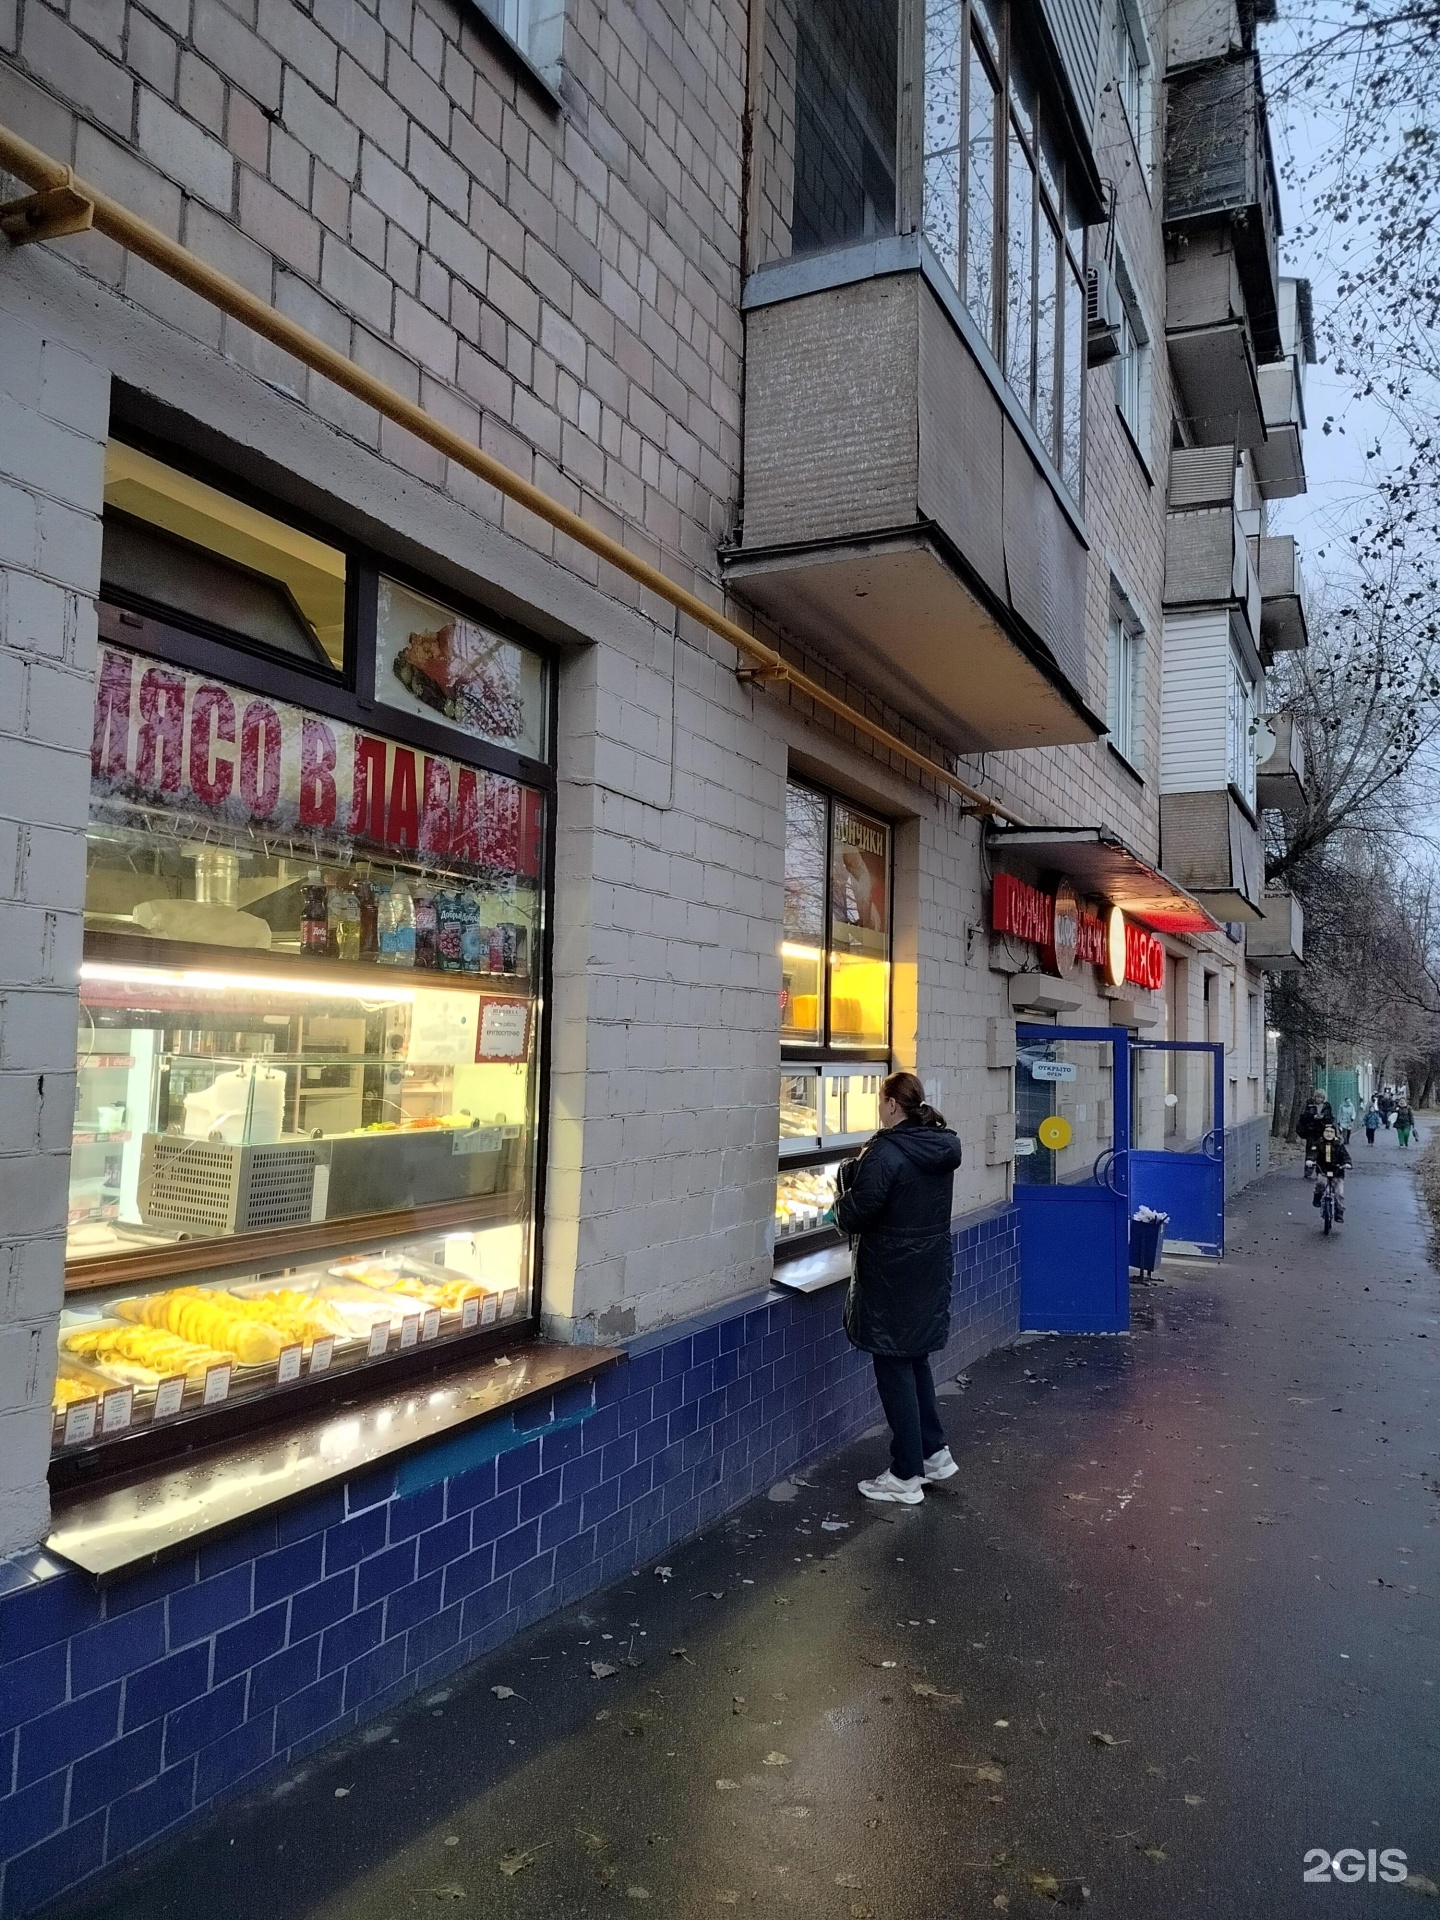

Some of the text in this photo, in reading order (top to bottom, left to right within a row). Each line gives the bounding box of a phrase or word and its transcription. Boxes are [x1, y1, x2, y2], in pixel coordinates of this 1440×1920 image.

[299, 717, 337, 827] В
[1126, 925, 1163, 988] МЯСО
[1038, 1065, 1072, 1073] ОТКРЫТО
